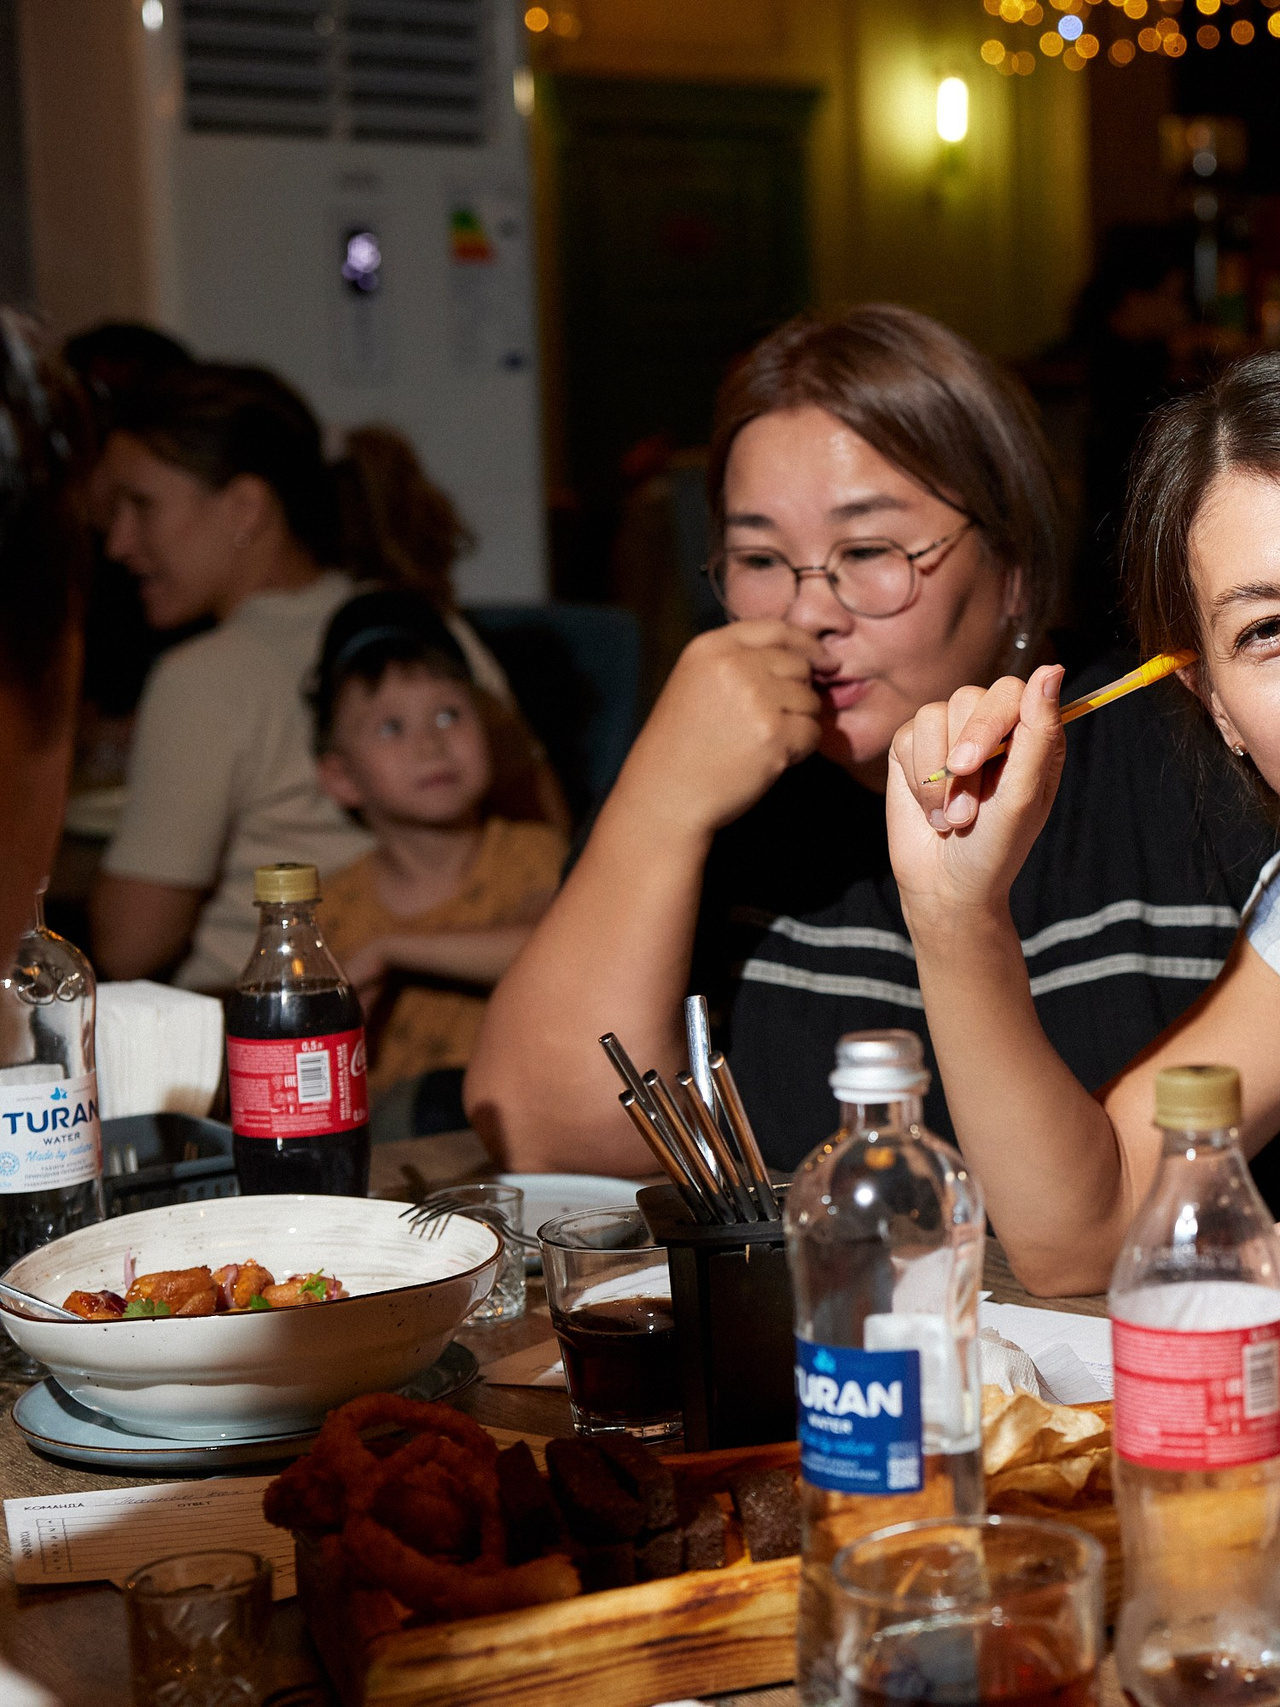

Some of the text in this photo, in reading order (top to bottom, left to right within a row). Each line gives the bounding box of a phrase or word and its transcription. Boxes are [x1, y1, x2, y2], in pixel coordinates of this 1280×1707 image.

[2, 1099, 99, 1135] TURAN
[43, 1132, 81, 1146] WATER
[794, 1365, 904, 1419] URAN
[24, 1502, 85, 1511] КОМАНДА
